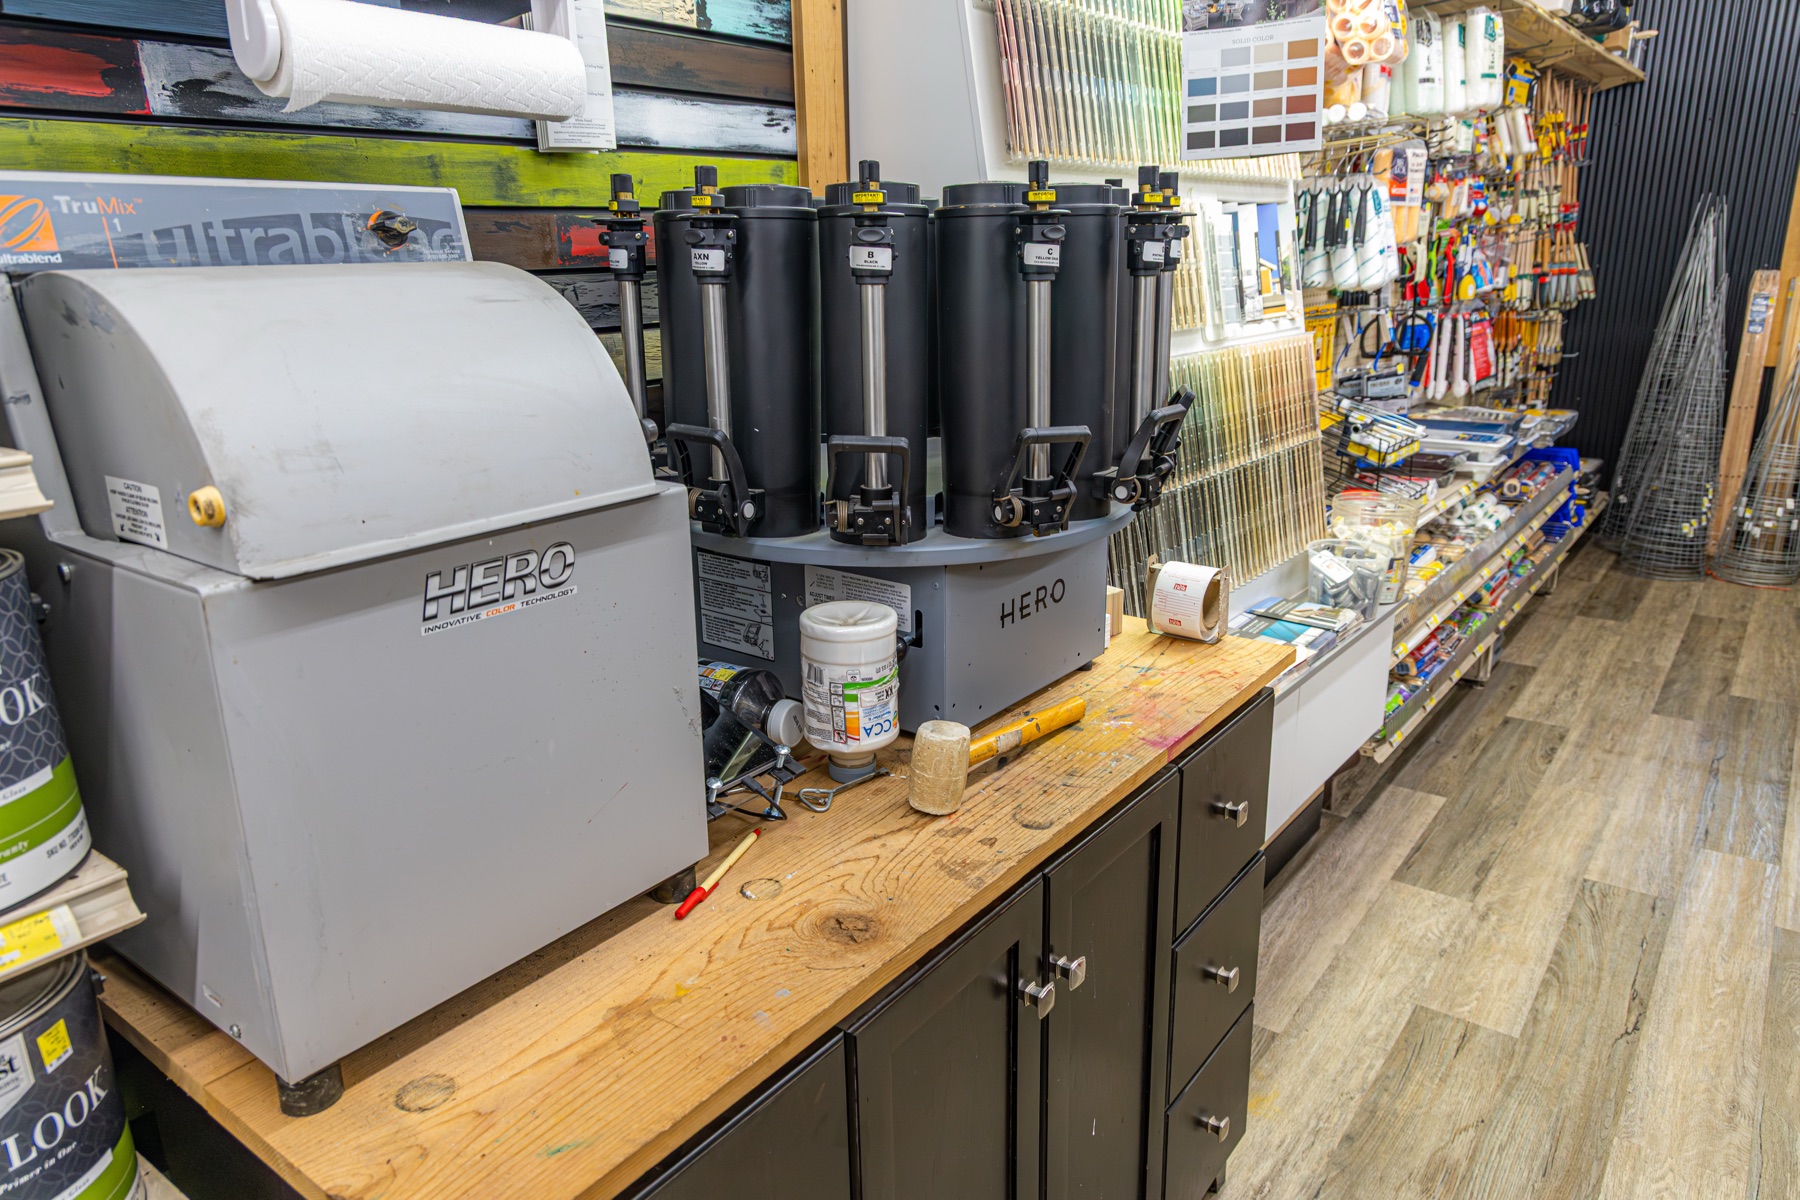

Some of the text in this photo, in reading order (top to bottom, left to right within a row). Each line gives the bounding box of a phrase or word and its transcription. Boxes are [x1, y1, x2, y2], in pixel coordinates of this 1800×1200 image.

[422, 542, 575, 622] HERO
[1000, 578, 1066, 628] HERO
[424, 587, 575, 634] INNOVATIVE COLOR TECHNOLOGY
[885, 685, 893, 700] XX
[863, 719, 892, 738] CCA
[1, 1065, 108, 1172] LOOK
[44, 1157, 56, 1170] in
